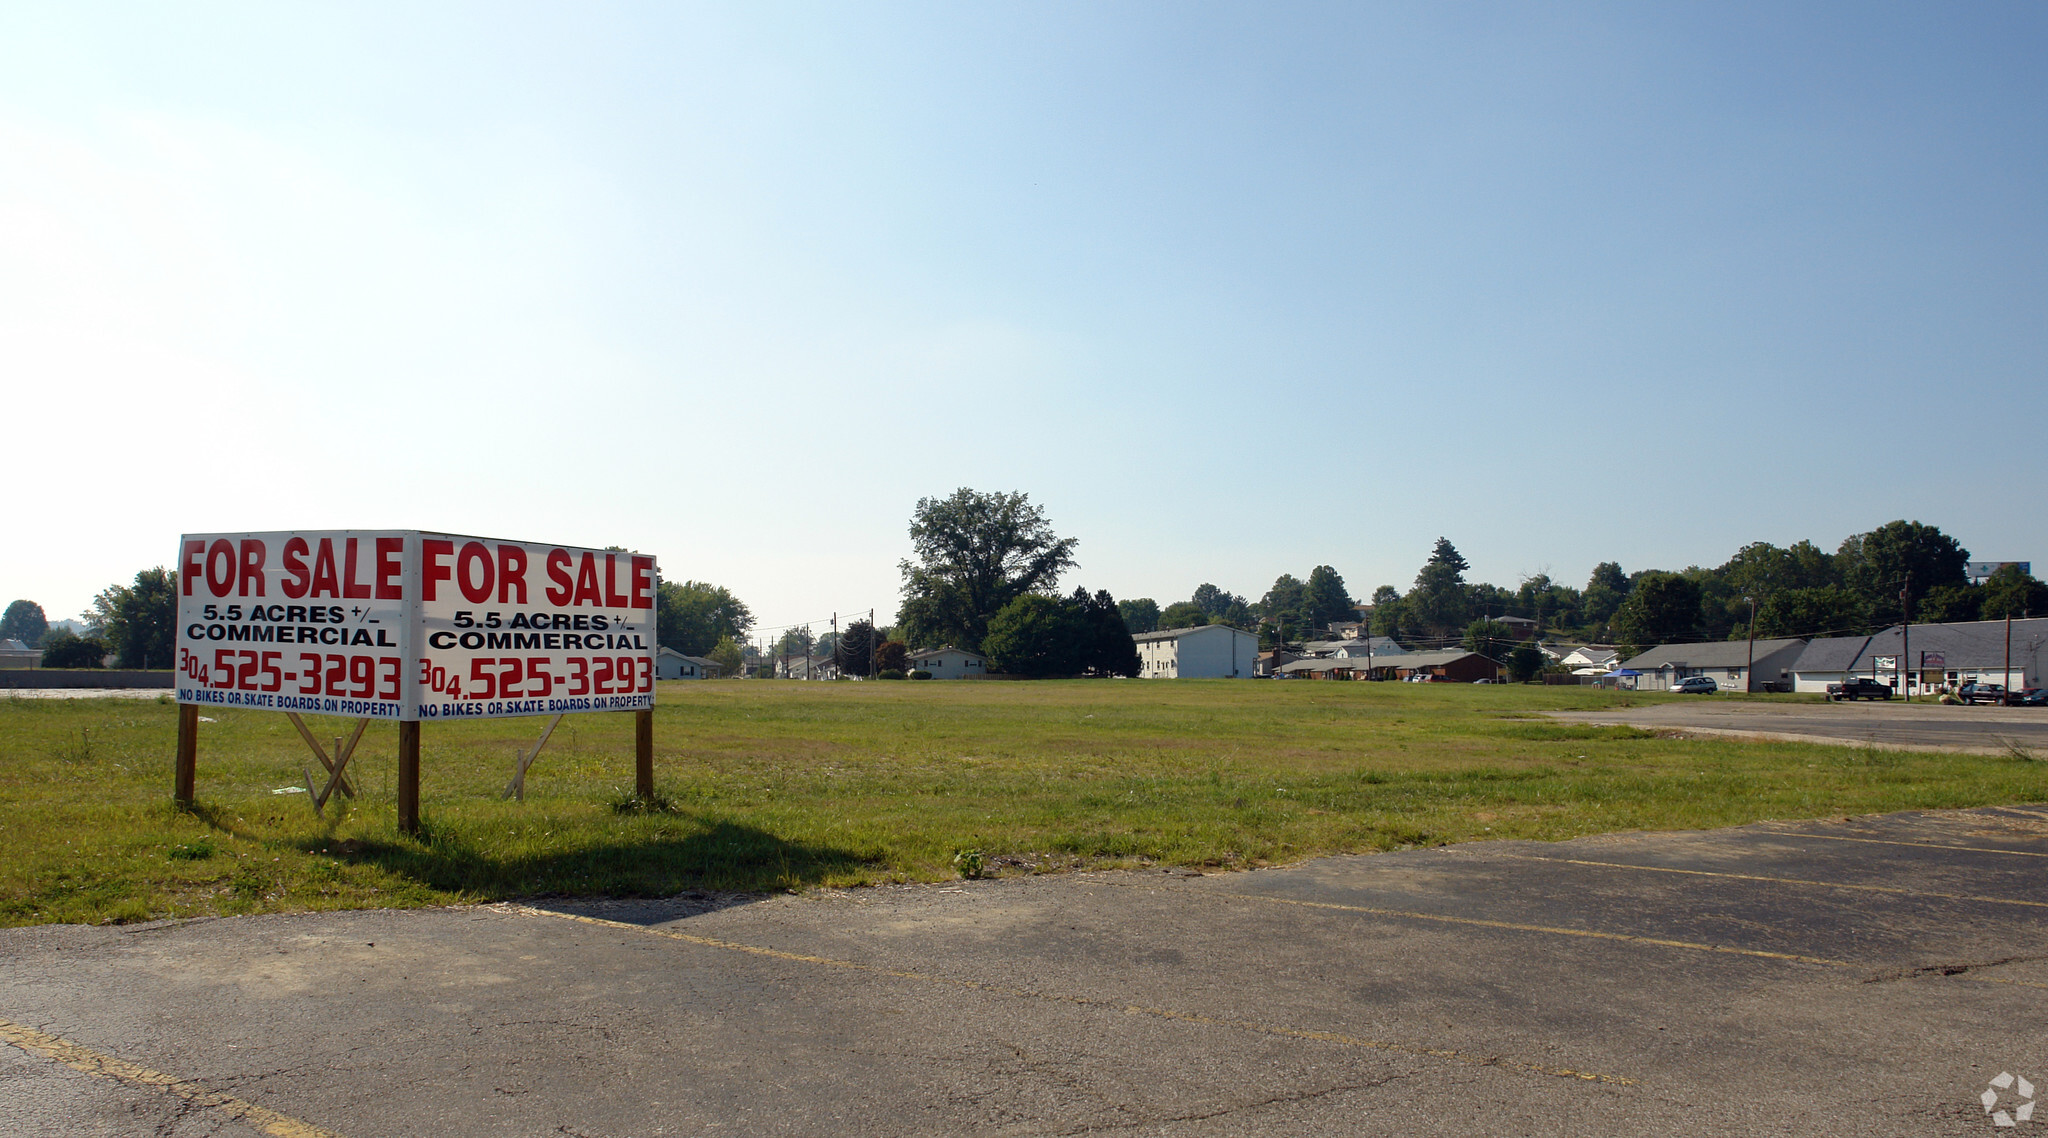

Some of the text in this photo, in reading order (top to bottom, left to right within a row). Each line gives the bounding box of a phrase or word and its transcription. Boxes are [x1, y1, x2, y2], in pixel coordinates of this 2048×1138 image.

[182, 536, 404, 600] FOR SALE
[422, 539, 653, 609] FOR SALE
[203, 605, 243, 621] 5.5
[249, 605, 345, 624] ACRES
[453, 611, 502, 629] 5.5
[509, 612, 609, 631] ACRES
[187, 623, 397, 647] COMMERCIAL
[428, 631, 648, 650] COMMERCIAL
[179, 688, 401, 717] NO BIKES OR SKATE BOARDS ON PROPERTY
[418, 695, 653, 718] NO BIKES OR SKATE BOARDS ON PROPERTY
